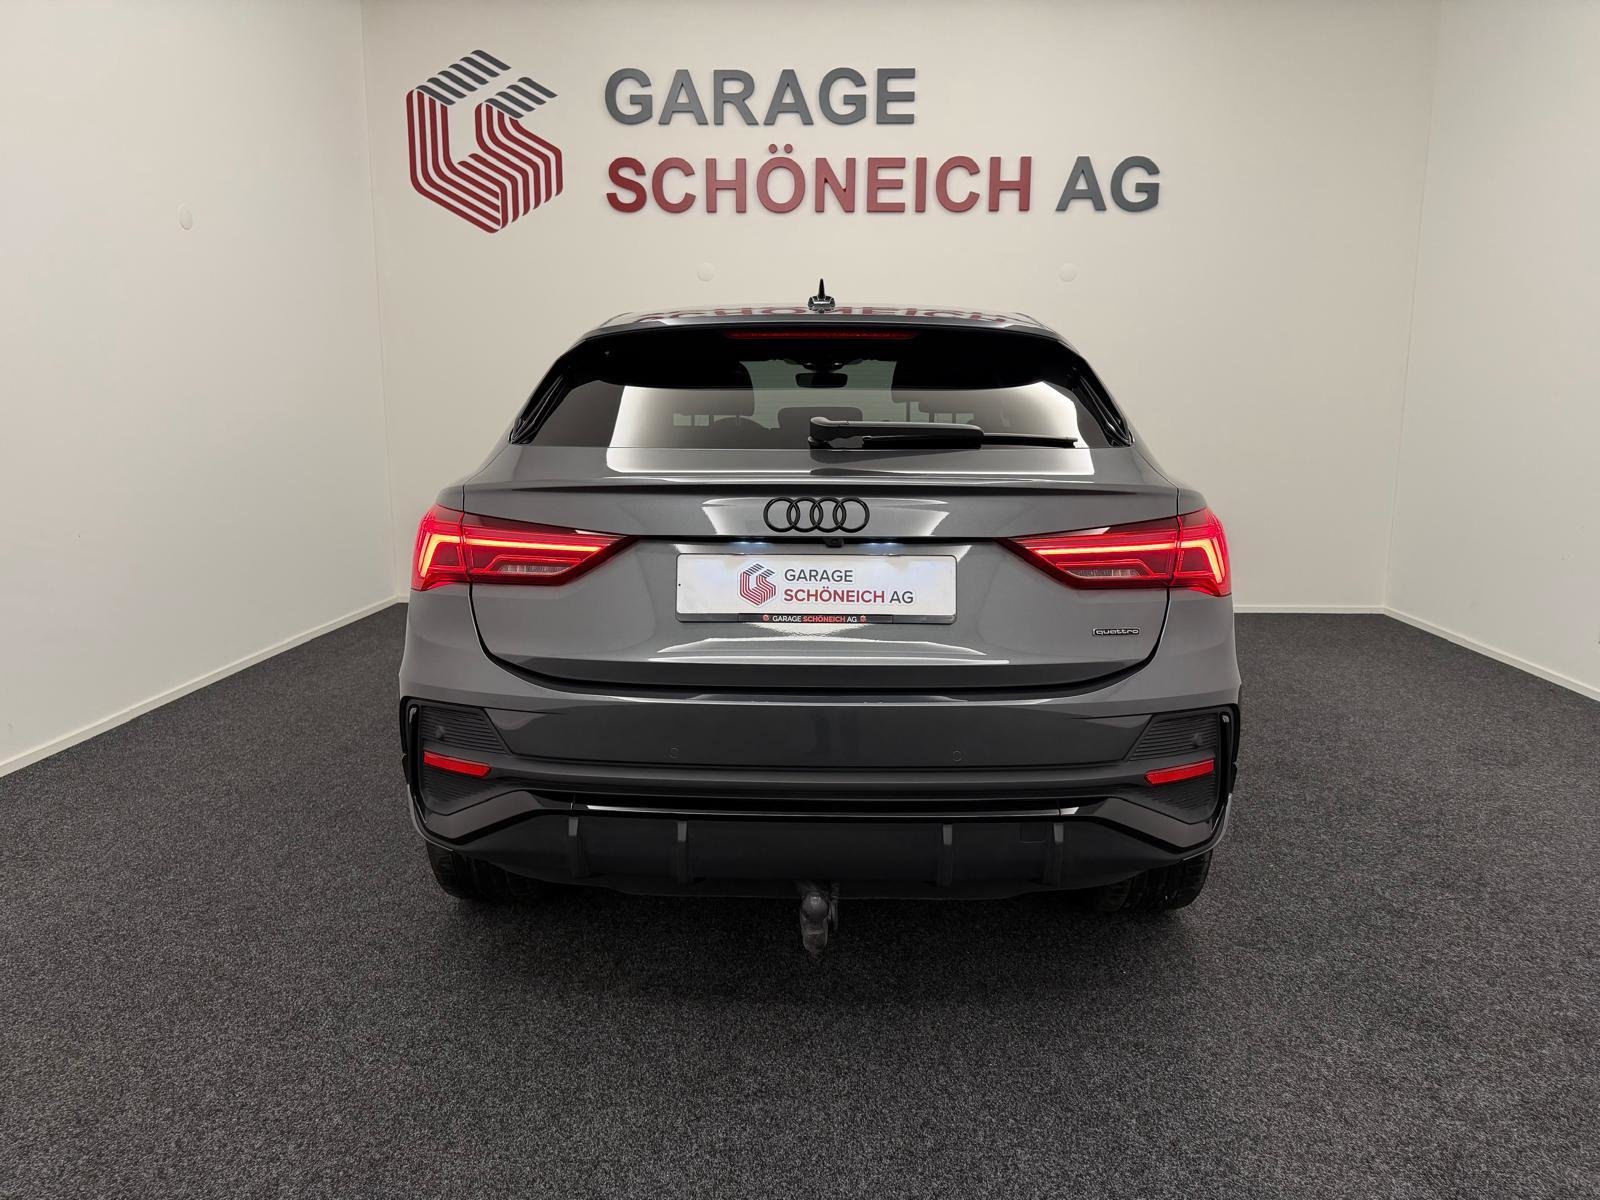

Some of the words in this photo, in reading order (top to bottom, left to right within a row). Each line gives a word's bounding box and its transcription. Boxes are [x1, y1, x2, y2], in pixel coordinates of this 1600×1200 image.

[604, 67, 916, 126] GARAGE
[606, 143, 1032, 214] SCHÖNEICH
[1055, 156, 1161, 213] AG
[784, 569, 853, 582] GARAGE
[783, 586, 885, 603] SCHÖNEICH
[889, 591, 914, 604] AG
